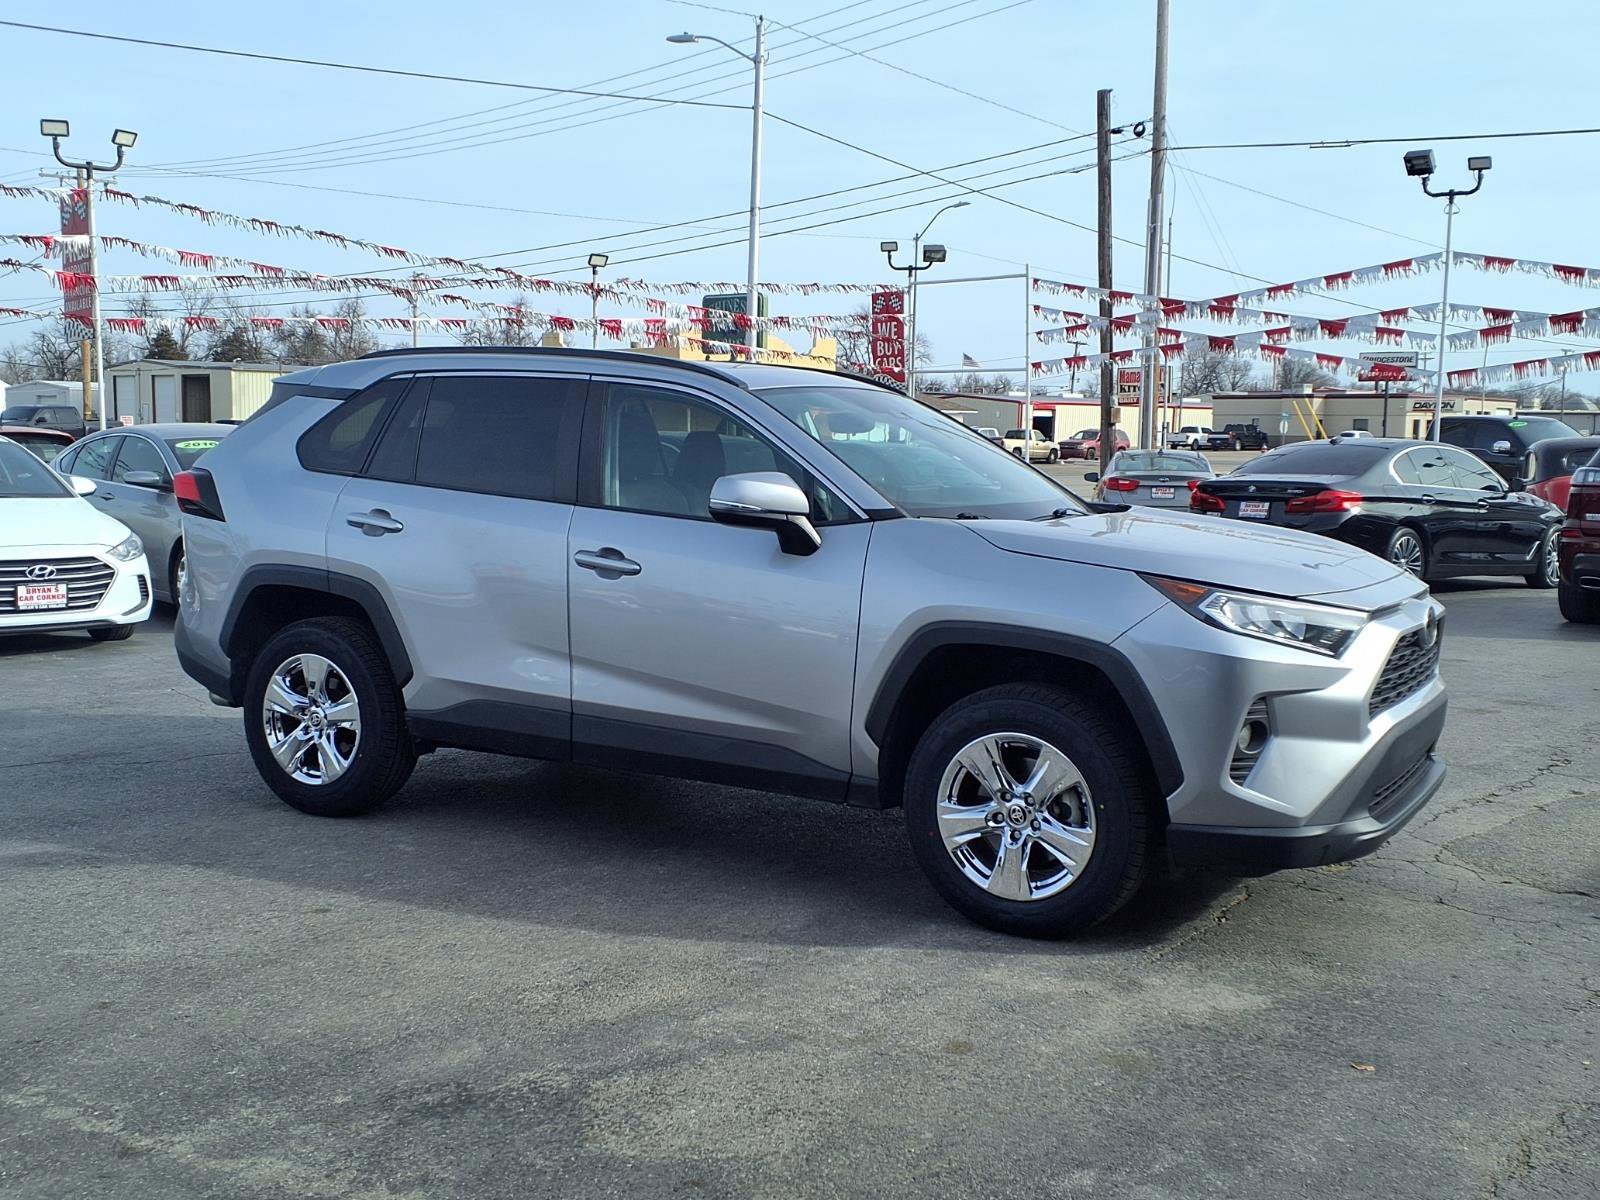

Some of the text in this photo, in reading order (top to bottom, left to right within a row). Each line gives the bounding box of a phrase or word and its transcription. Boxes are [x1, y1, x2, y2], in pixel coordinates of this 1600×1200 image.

[877, 321, 898, 339] WE
[876, 340, 902, 357] BUY
[875, 356, 903, 371] CARS
[26, 584, 60, 595] BRYANS
